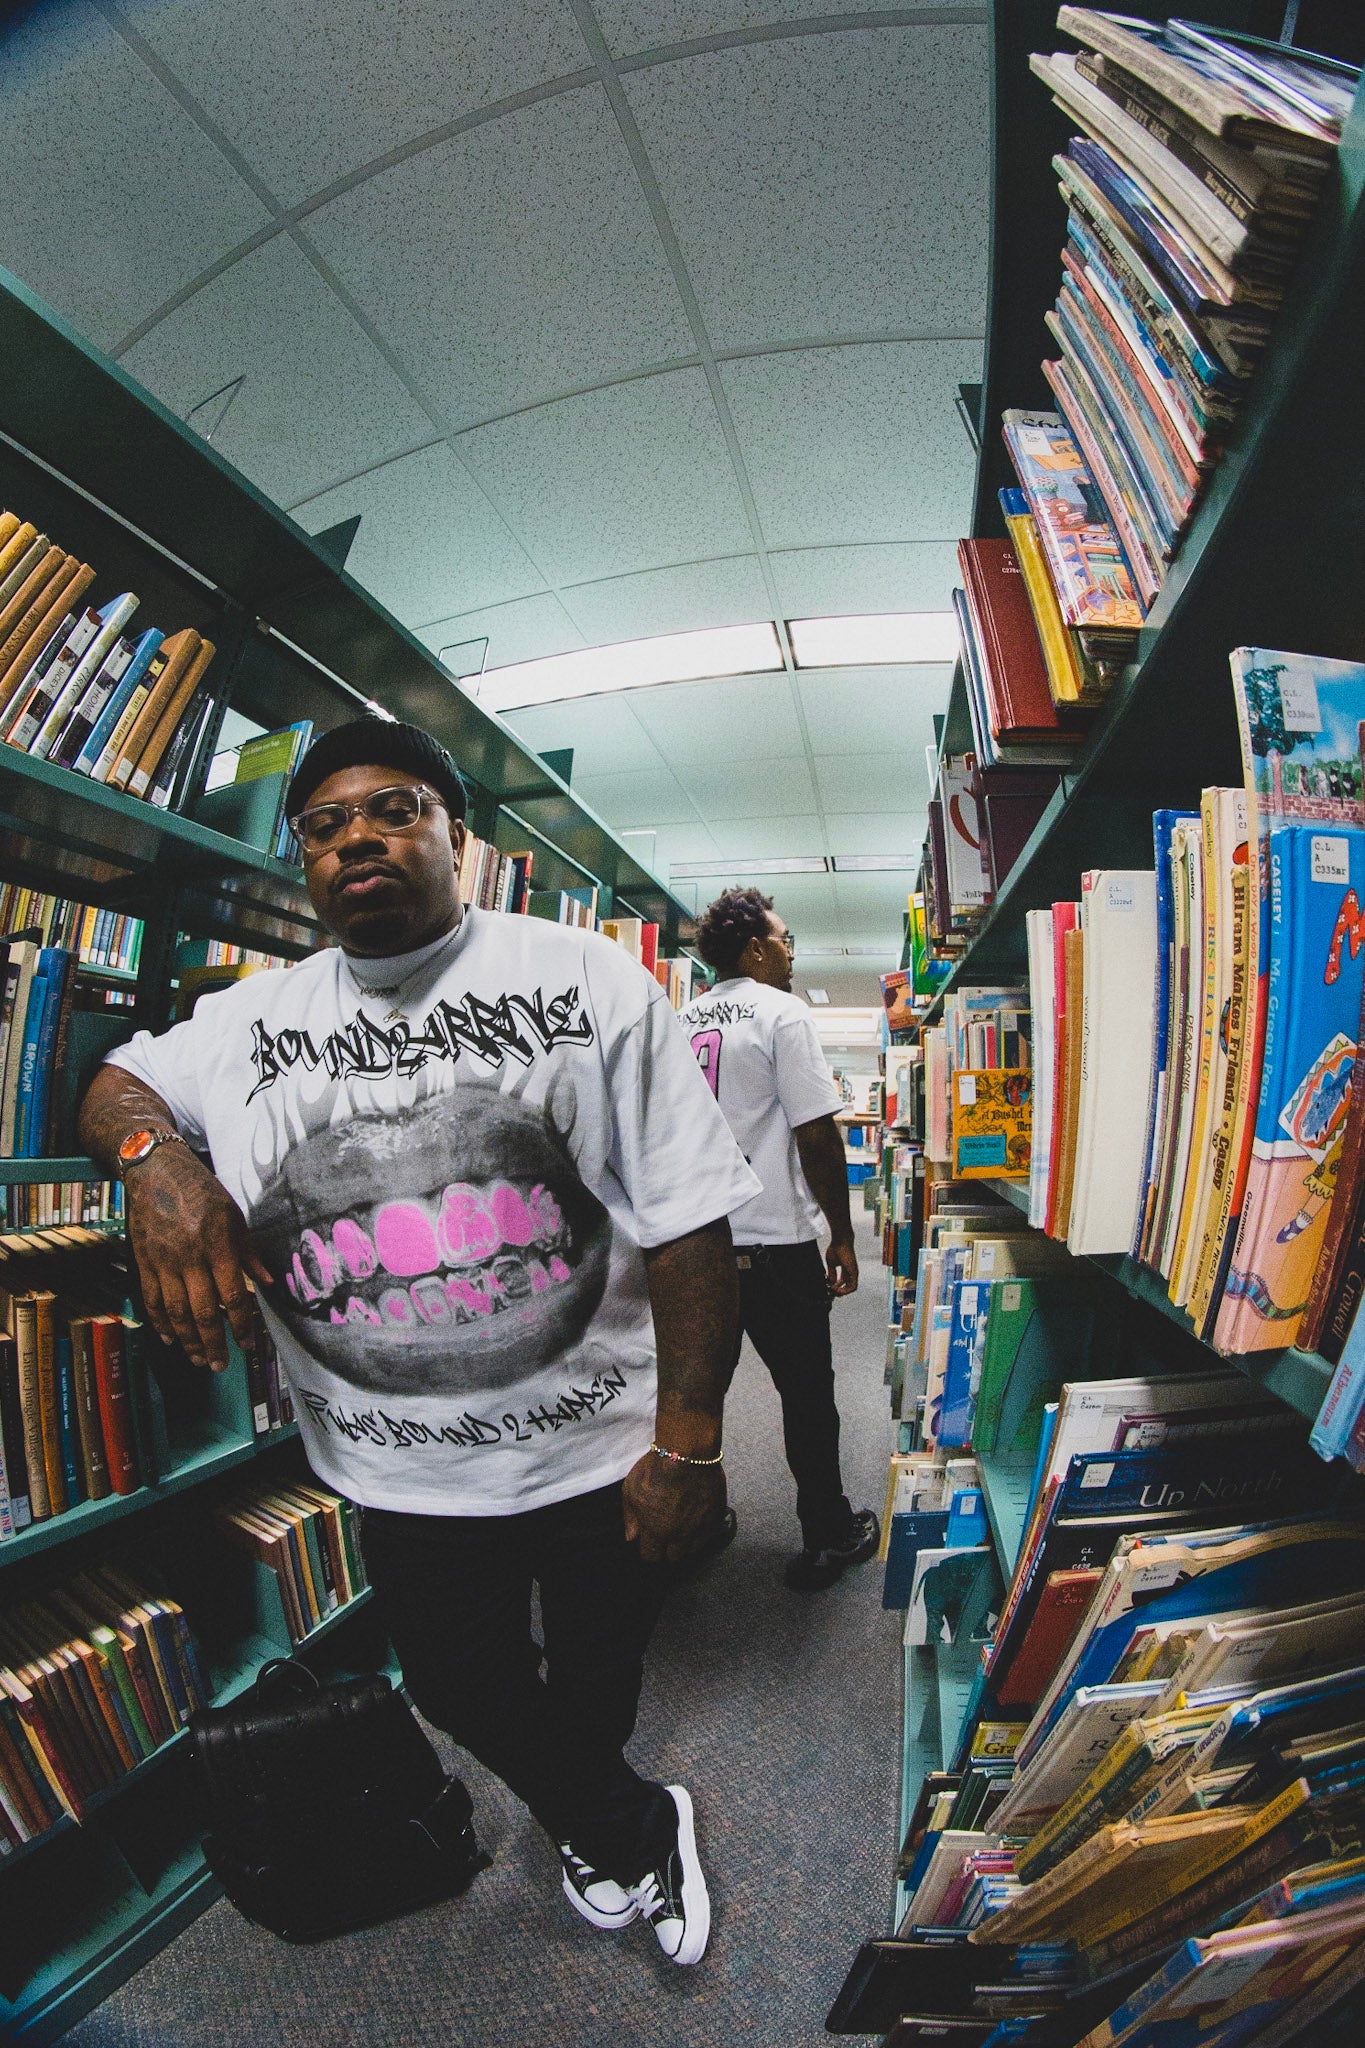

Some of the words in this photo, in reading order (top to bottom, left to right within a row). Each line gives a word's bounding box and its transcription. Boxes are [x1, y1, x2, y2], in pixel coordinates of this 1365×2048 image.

[79, 686, 104, 720] HOME
[1201, 807, 1216, 858] Caseley
[1314, 842, 1335, 851] C.L.
[1315, 853, 1321, 862] A
[1270, 853, 1282, 925] CASELEY
[1232, 884, 1246, 956] Hiram
[1204, 910, 1217, 1019] PRISCILLA
[1268, 956, 1282, 989] Mr.
[1228, 961, 1245, 1030] Makes
[1263, 994, 1280, 1058] Green
[19, 1041, 37, 1093] BROWN
[1198, 1027, 1215, 1093] TWICE
[1218, 1035, 1244, 1112] Friends
[1257, 1062, 1273, 1109] Peas
[1210, 1135, 1231, 1192] Casey
[1232, 1189, 1254, 1257] Greenwillow
[1329, 1269, 1365, 1344] Crowell
[377, 1411, 501, 1450] BOUND
[502, 1413, 532, 1441] 2
[523, 1364, 627, 1432] HAPPEN
[0, 1506, 12, 1535] MIND
[1139, 1483, 1185, 1508] Up
[1193, 1718, 1230, 1758] Chapman
